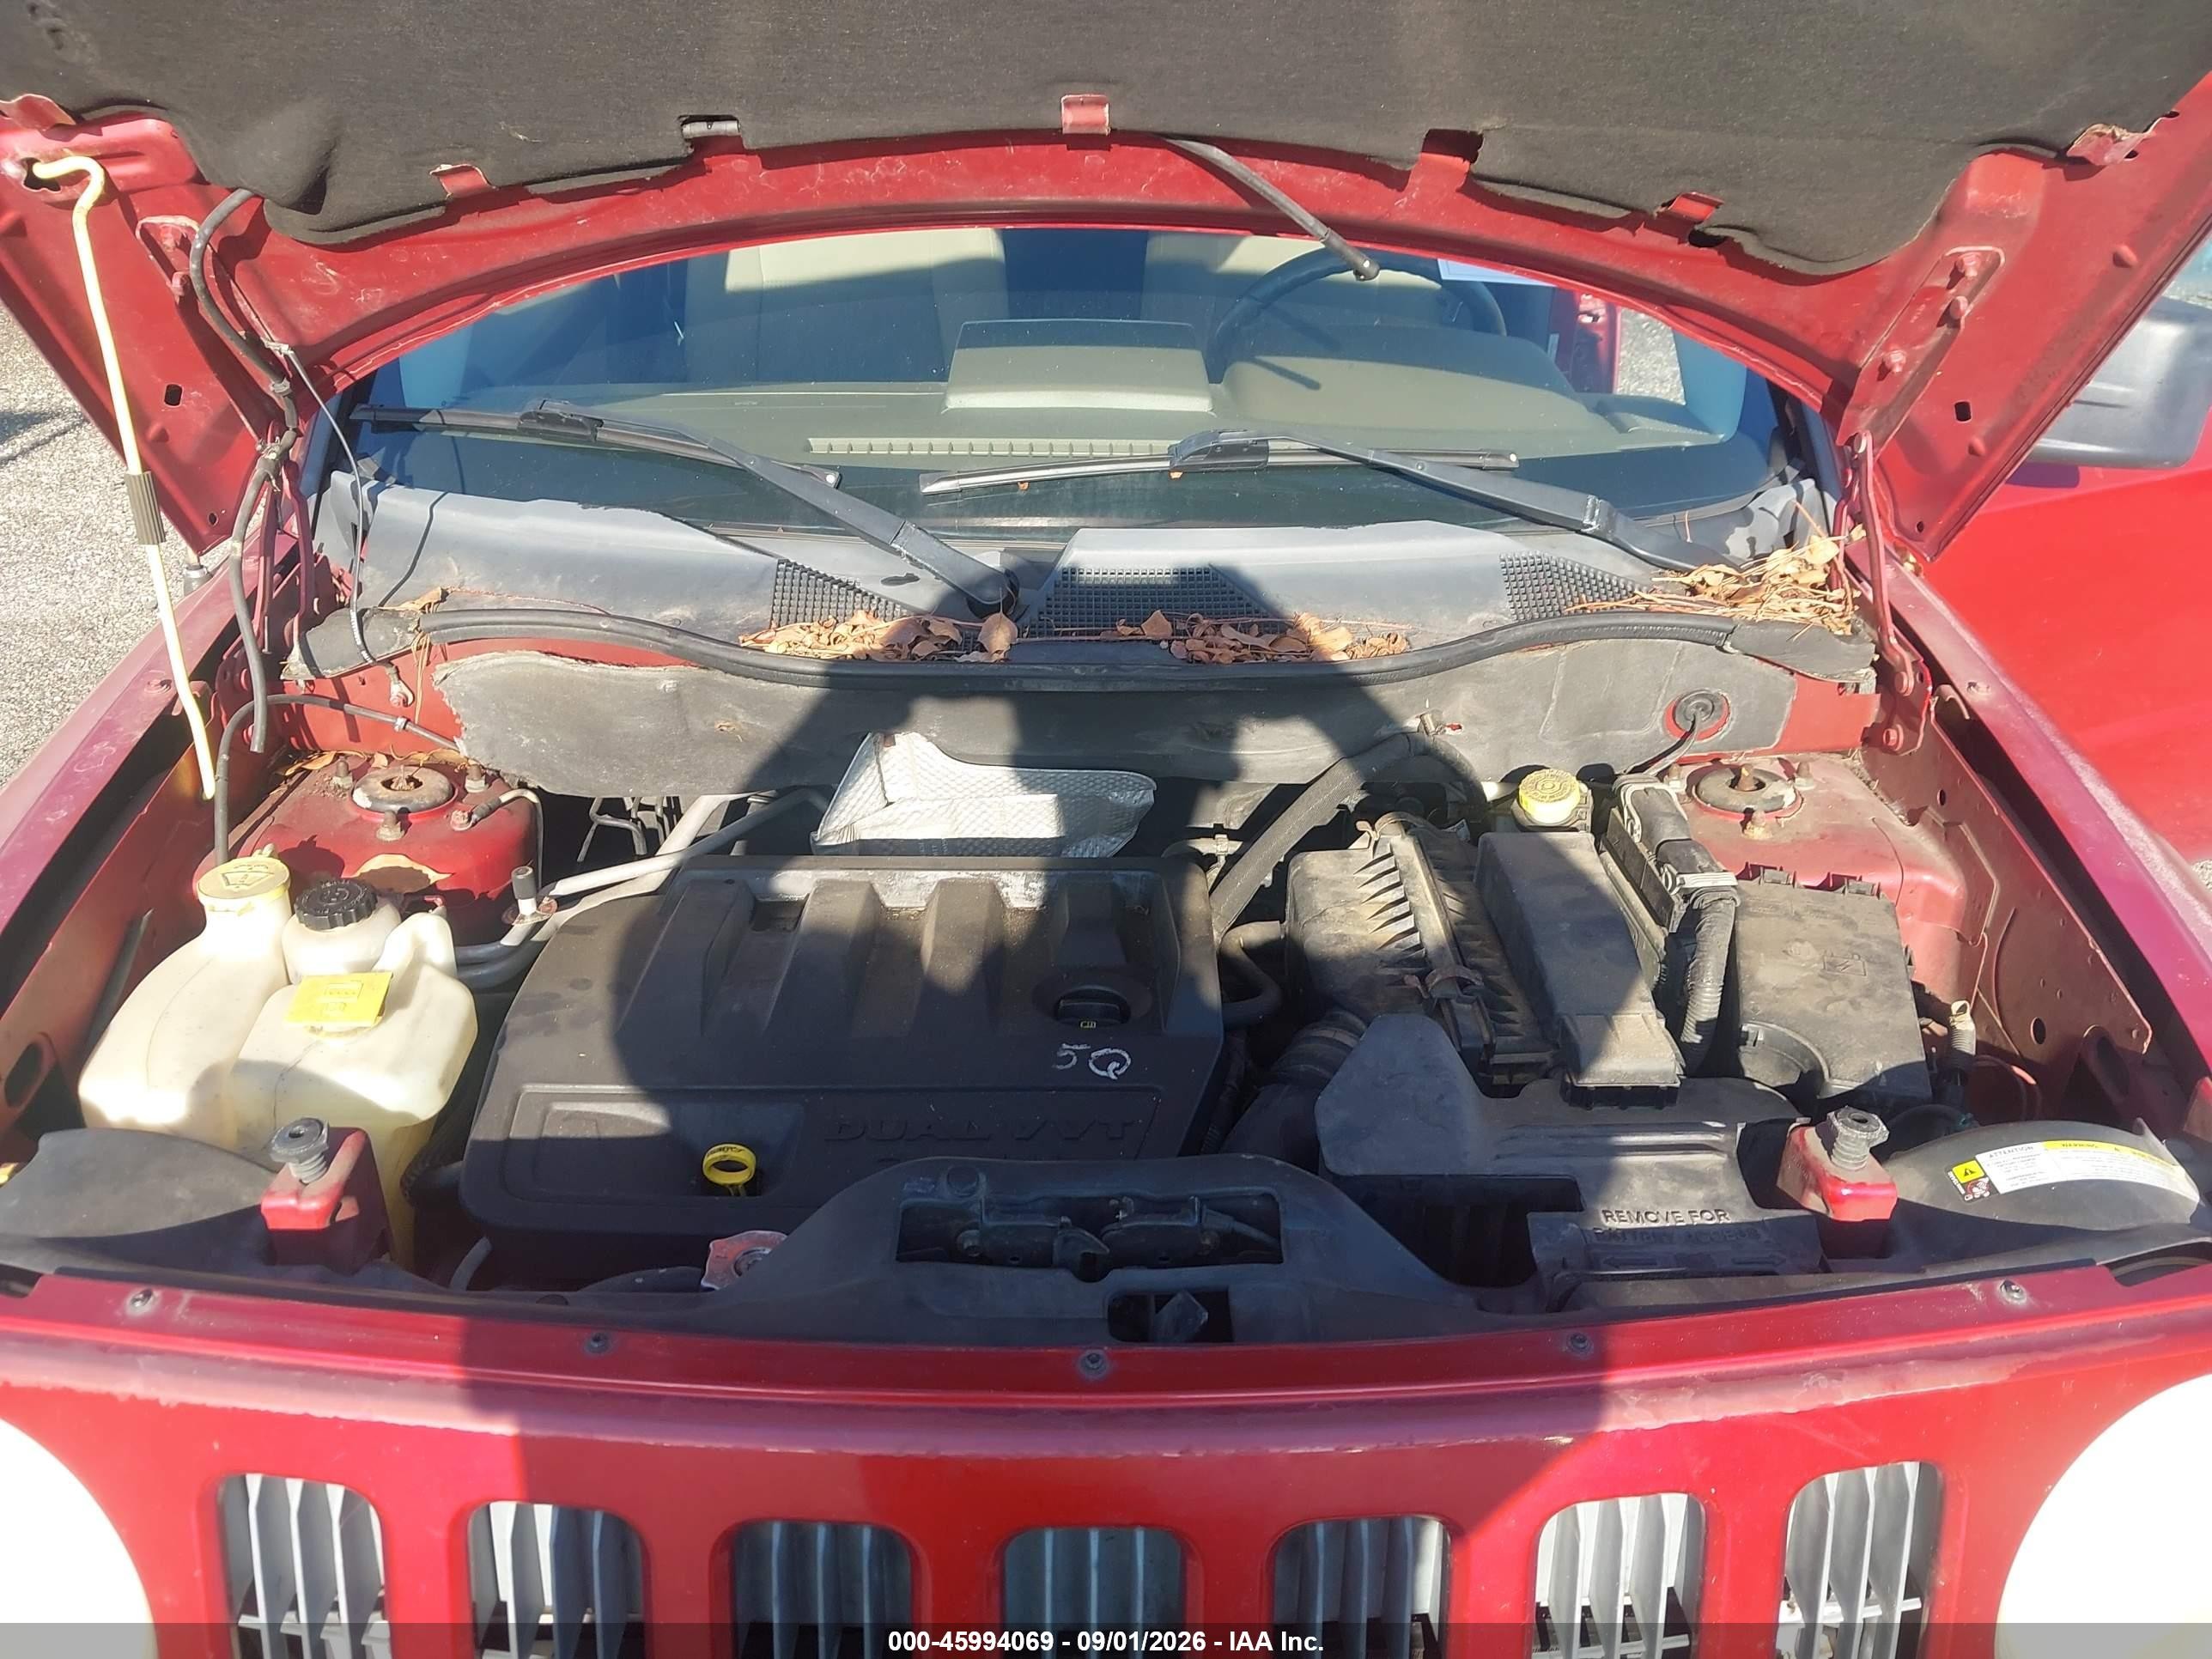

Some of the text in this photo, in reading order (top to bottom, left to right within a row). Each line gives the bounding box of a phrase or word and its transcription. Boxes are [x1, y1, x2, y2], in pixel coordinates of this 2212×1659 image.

[823, 1118, 1136, 1142] DUAL VVT
[1601, 1208, 1731, 1225] REMOVE FOR
